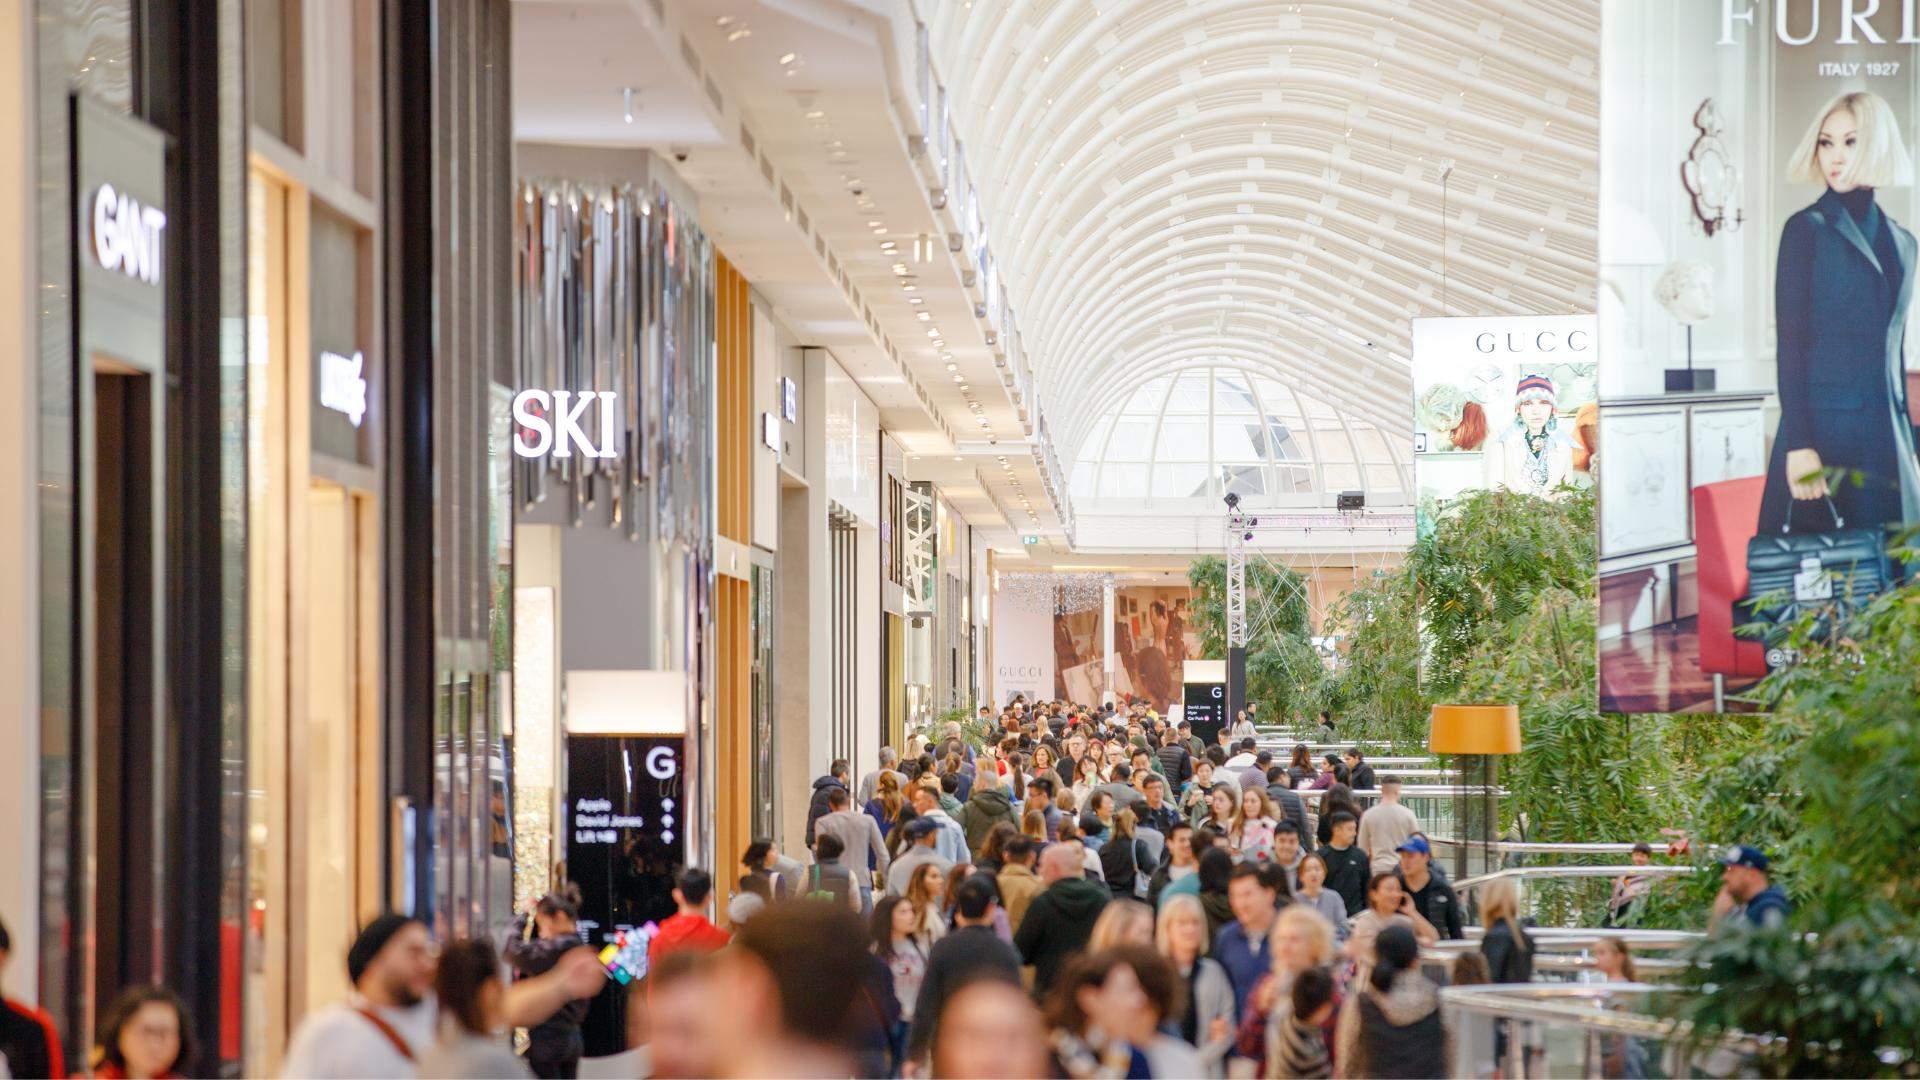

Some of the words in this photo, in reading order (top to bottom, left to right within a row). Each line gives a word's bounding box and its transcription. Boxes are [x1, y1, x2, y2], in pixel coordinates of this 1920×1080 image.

[1819, 62, 1860, 76] ITALY
[1866, 62, 1900, 76] 1927
[94, 183, 166, 286] GANT
[1476, 330, 1588, 353] GUCC
[513, 389, 617, 458] SKI
[1000, 666, 1042, 677] GUCCI
[1211, 686, 1222, 698] G
[645, 746, 676, 779] G
[576, 798, 612, 813] Apple
[575, 814, 610, 828] David
[610, 814, 643, 828] Jones
[575, 830, 596, 844] Lift
